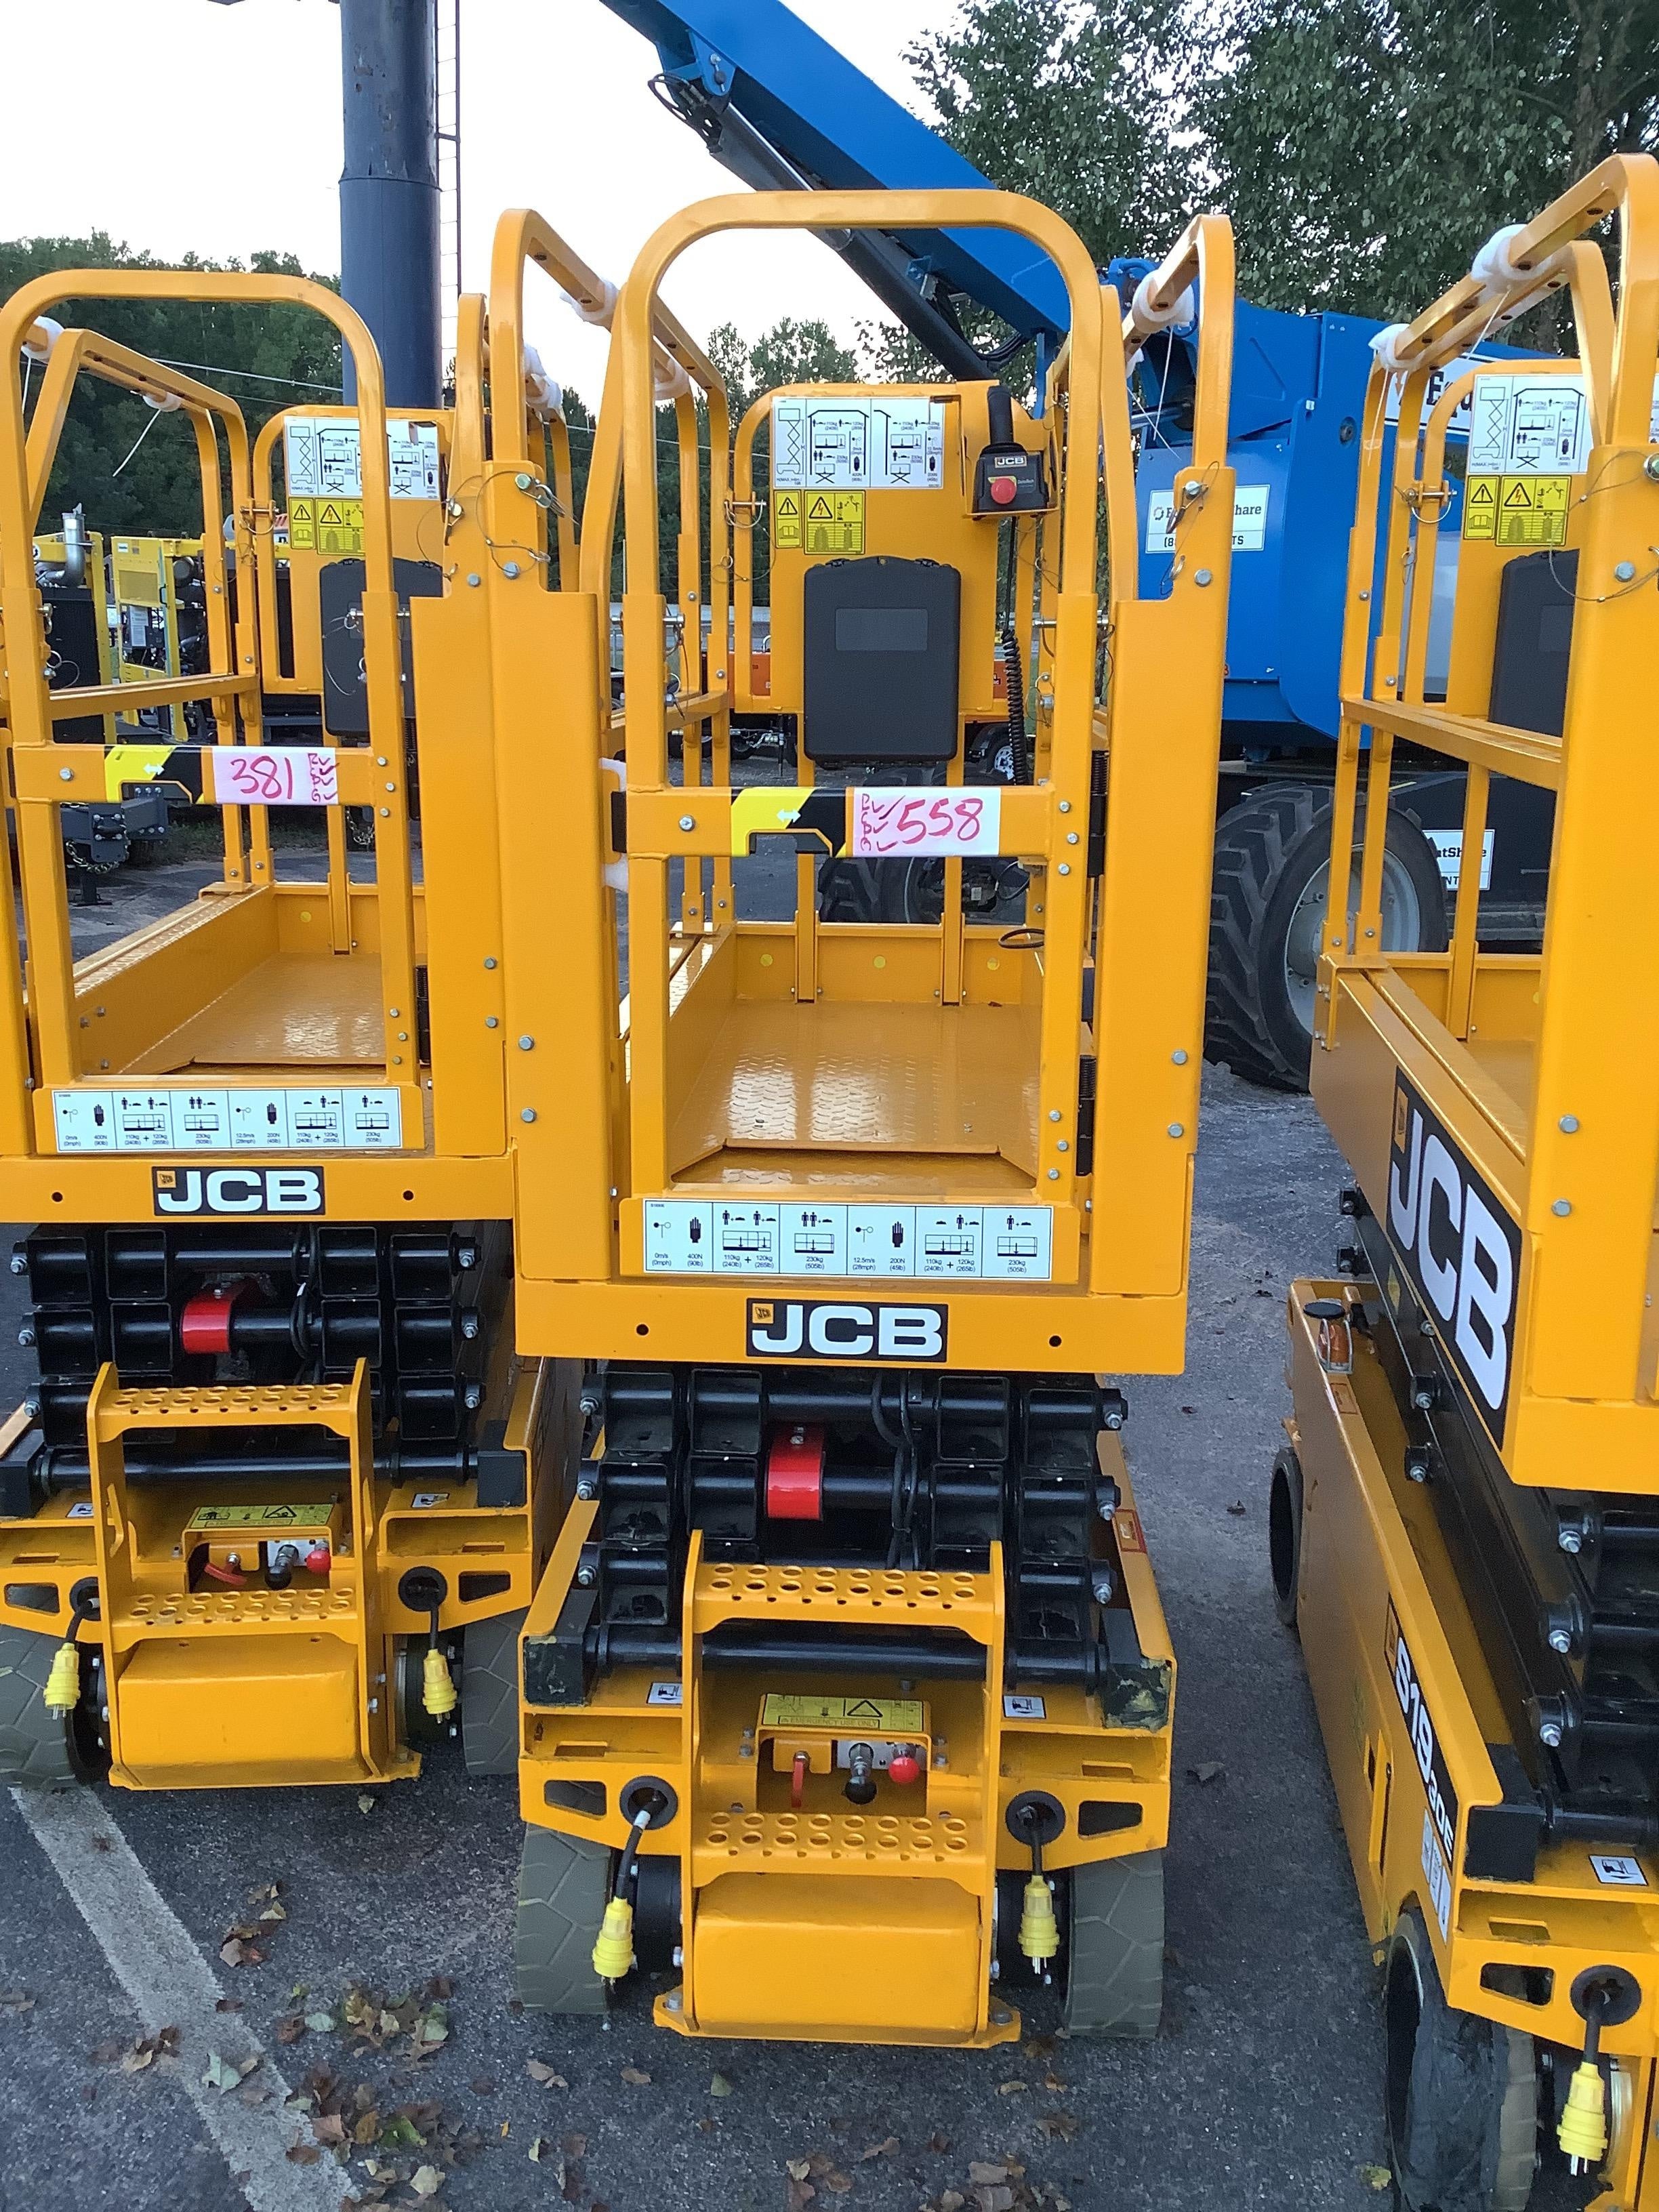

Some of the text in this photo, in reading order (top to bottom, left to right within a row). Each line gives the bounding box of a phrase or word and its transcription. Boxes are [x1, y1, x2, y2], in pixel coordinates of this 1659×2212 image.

[998, 457, 1024, 466] JCB
[230, 756, 293, 800] 381
[897, 798, 983, 844] 558
[158, 1170, 322, 1212] JCB
[1391, 1109, 1513, 1410] JCB
[752, 1305, 943, 1357] JCB
